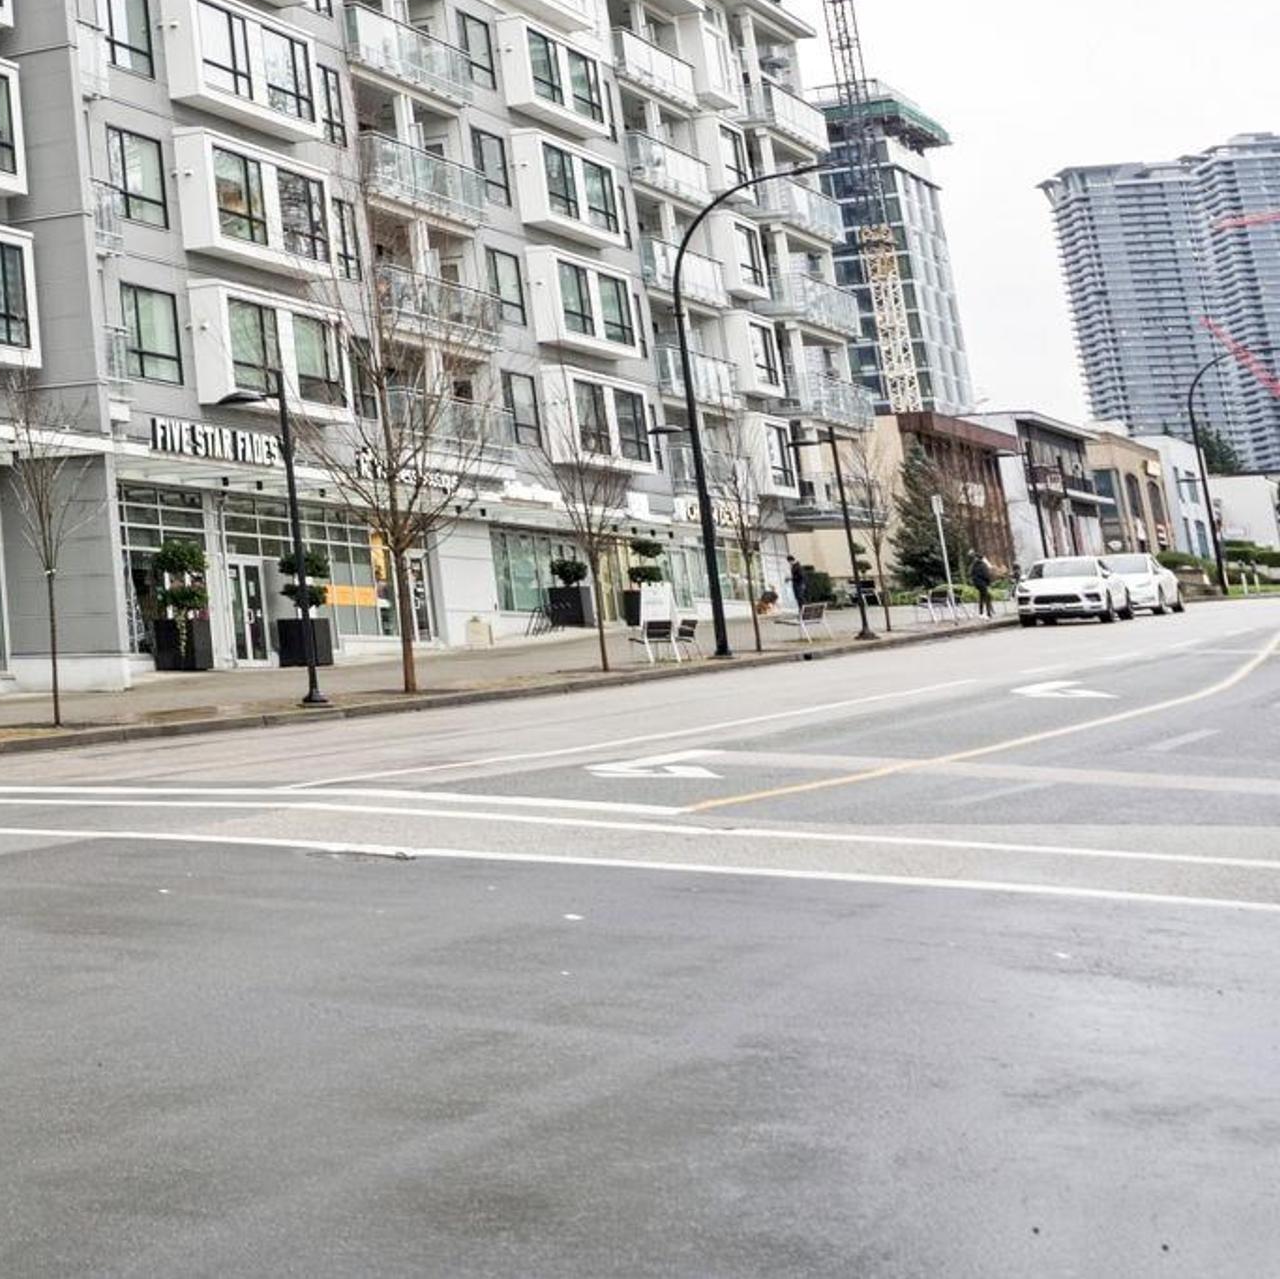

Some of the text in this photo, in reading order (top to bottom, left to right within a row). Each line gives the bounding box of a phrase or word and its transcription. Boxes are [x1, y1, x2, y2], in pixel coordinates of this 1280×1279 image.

[154, 417, 281, 466] FIVE STAR FADES
